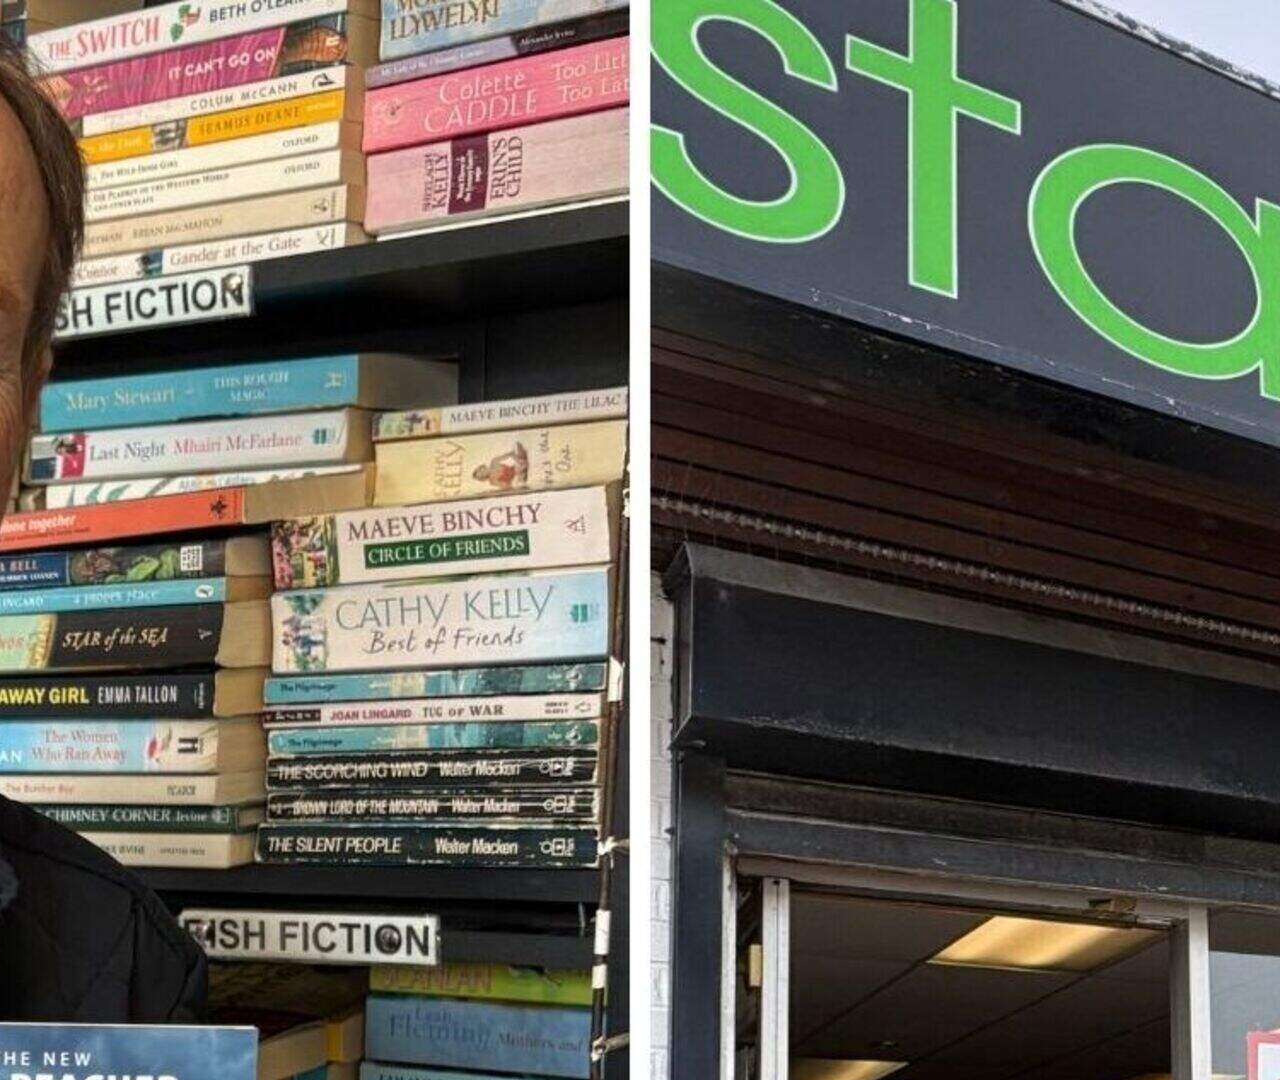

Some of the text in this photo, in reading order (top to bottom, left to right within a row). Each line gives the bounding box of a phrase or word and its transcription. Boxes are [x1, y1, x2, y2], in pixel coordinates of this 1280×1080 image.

[76, 4, 247, 58] SWITCH BETH
[228, 45, 277, 68] GO ON
[439, 71, 526, 104] Colette
[190, 93, 235, 112] COLUM
[424, 90, 538, 133] CADDLE
[105, 272, 245, 325] FICTION
[67, 384, 177, 411] Mary Stewart
[498, 402, 552, 421] BINCHY
[89, 428, 304, 462] Last Night Mhairi McFarlane
[347, 503, 542, 542] MAEVE BINCHY
[367, 533, 527, 566] CIRCLE OF FRIENDS
[334, 583, 557, 632] CATHY KELLY
[62, 627, 169, 651] STAR SEA
[368, 625, 526, 655] Best of Friends
[49, 688, 90, 705] GIRL
[97, 686, 132, 703] EMMA
[135, 684, 178, 703] TALLON
[361, 704, 505, 721] LINGARD WAR
[305, 761, 388, 781] SCORCHING
[111, 808, 171, 823] CORNER
[268, 836, 519, 856] THE SILENT PEOPLE Walter Macken
[278, 921, 430, 957] FICTION
[43, 1051, 91, 1066] NEW
